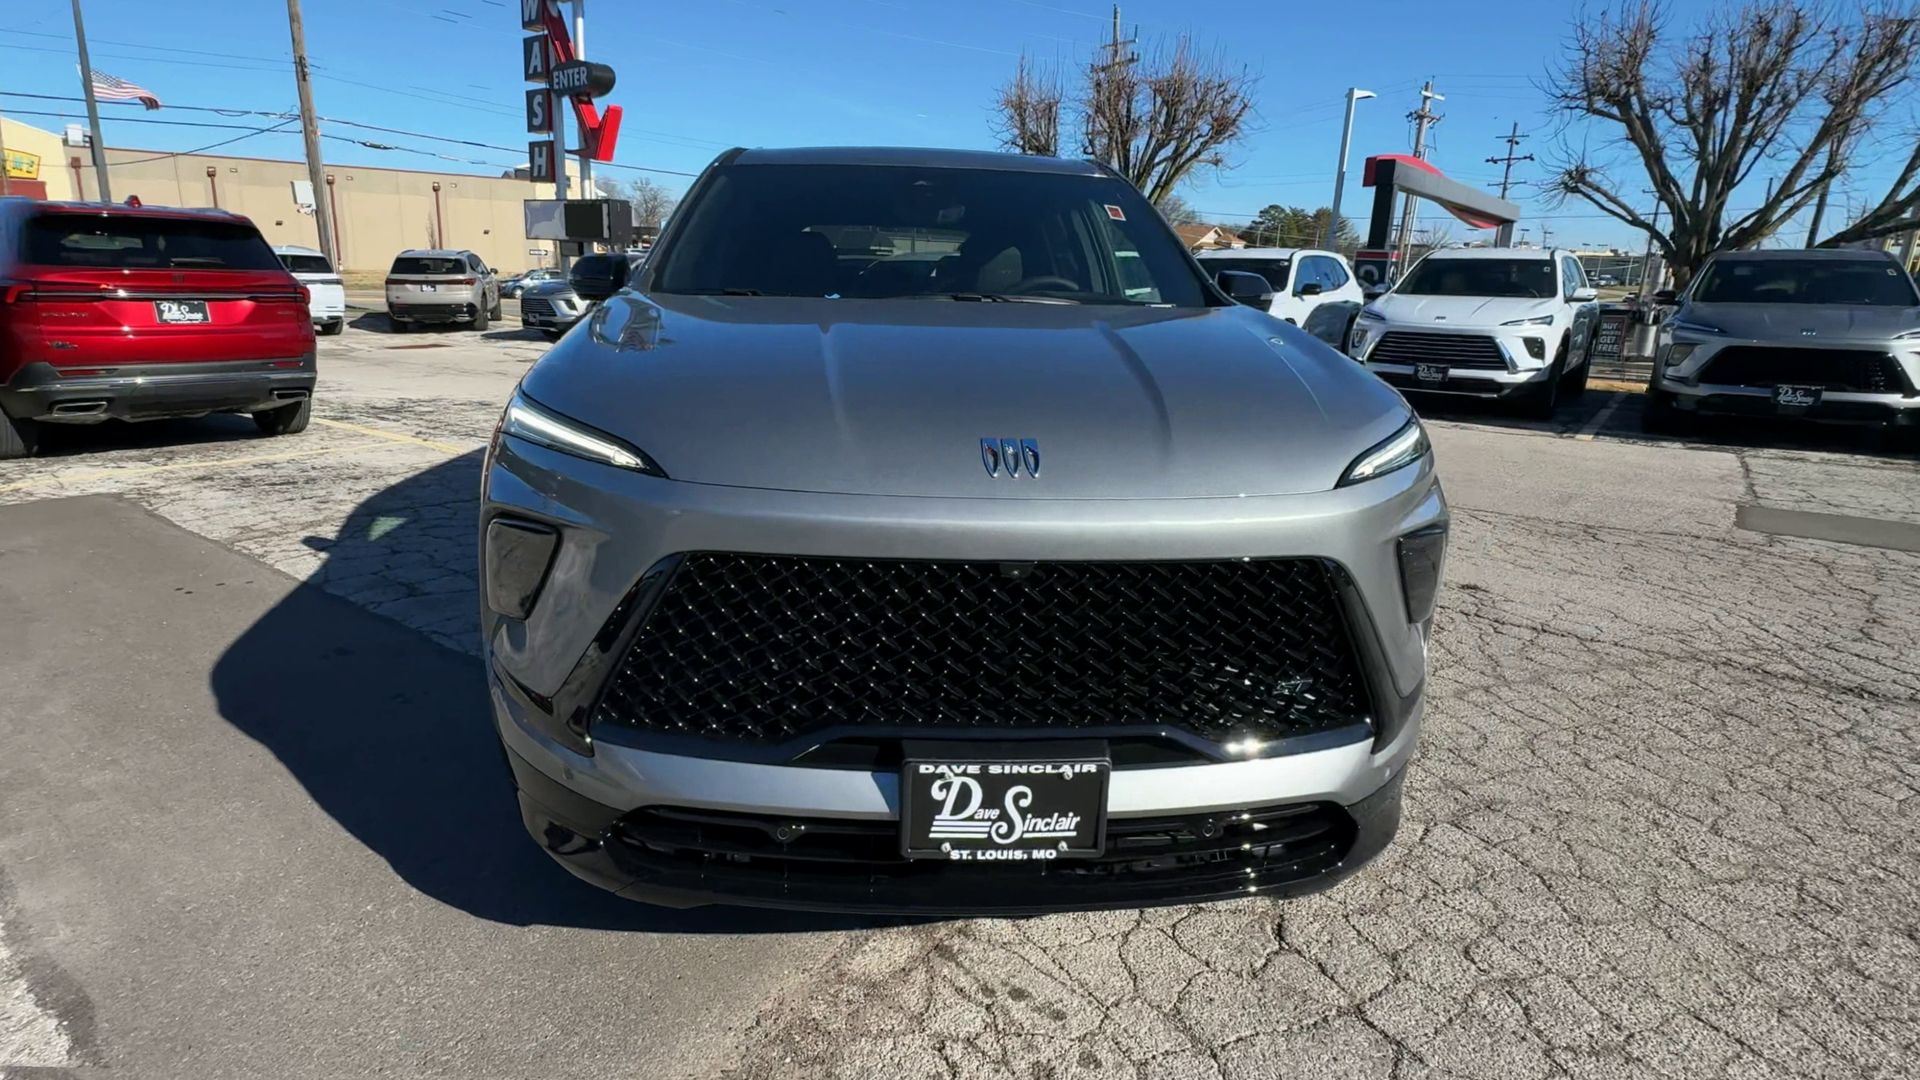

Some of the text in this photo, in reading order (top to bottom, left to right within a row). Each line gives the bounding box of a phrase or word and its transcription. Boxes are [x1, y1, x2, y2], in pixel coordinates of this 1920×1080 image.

[552, 67, 588, 90] ENTER
[523, 0, 548, 177] WASH
[1600, 335, 1616, 343] GET
[1598, 344, 1620, 352] FREE
[919, 763, 1097, 774] DAVE SINCLAIR
[931, 776, 1081, 844] Dave Sinclair
[950, 849, 1057, 861] ST. LOUIS, MO
